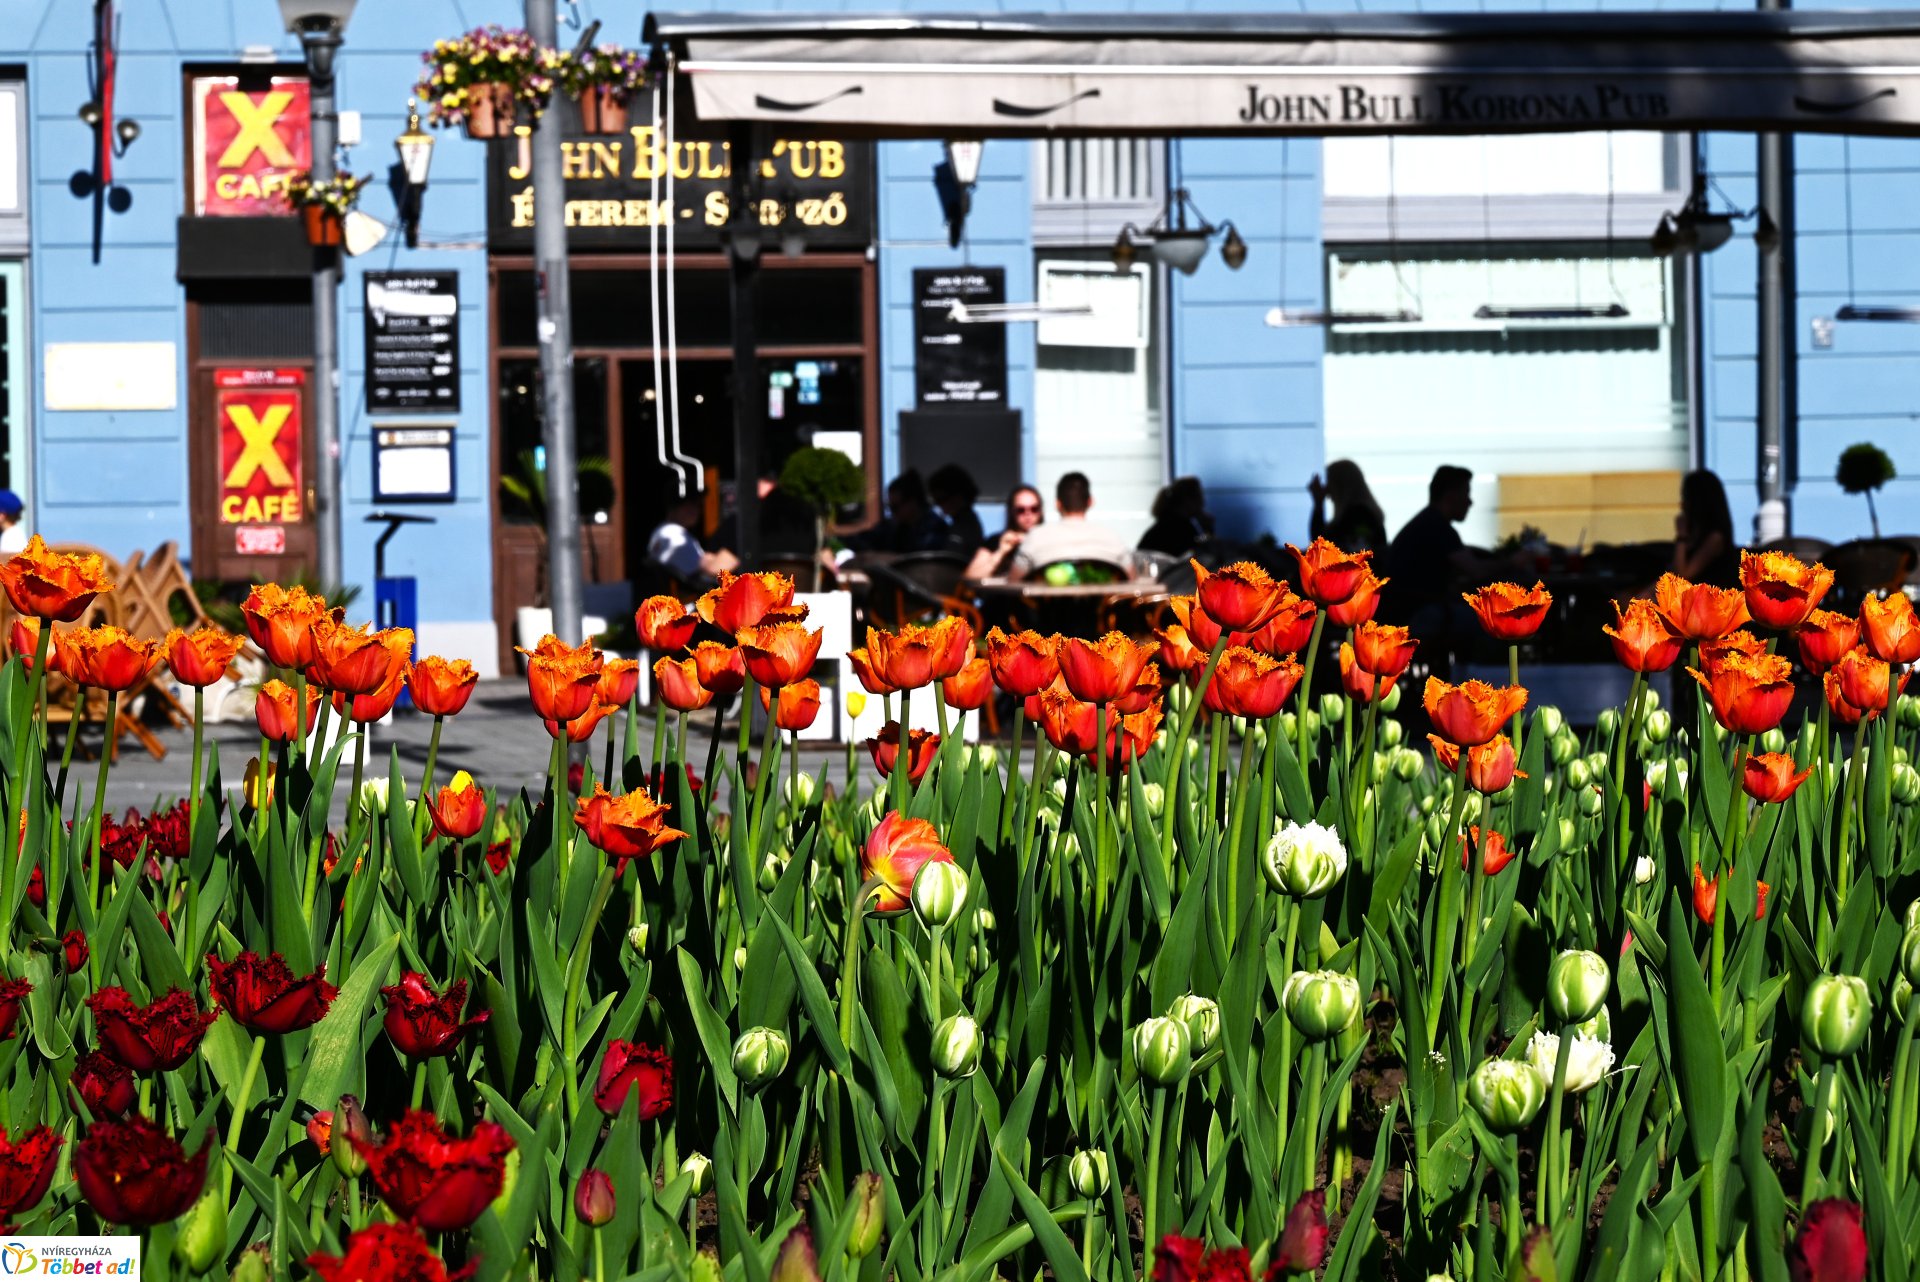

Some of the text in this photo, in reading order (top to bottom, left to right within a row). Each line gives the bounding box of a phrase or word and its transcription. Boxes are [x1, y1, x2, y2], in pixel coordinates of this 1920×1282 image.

[217, 91, 297, 168] X
[1239, 84, 1670, 123] JOHN BULL KORONA PUB
[508, 126, 622, 179] JHN
[224, 404, 295, 488] X
[221, 490, 300, 523] CAFÉ
